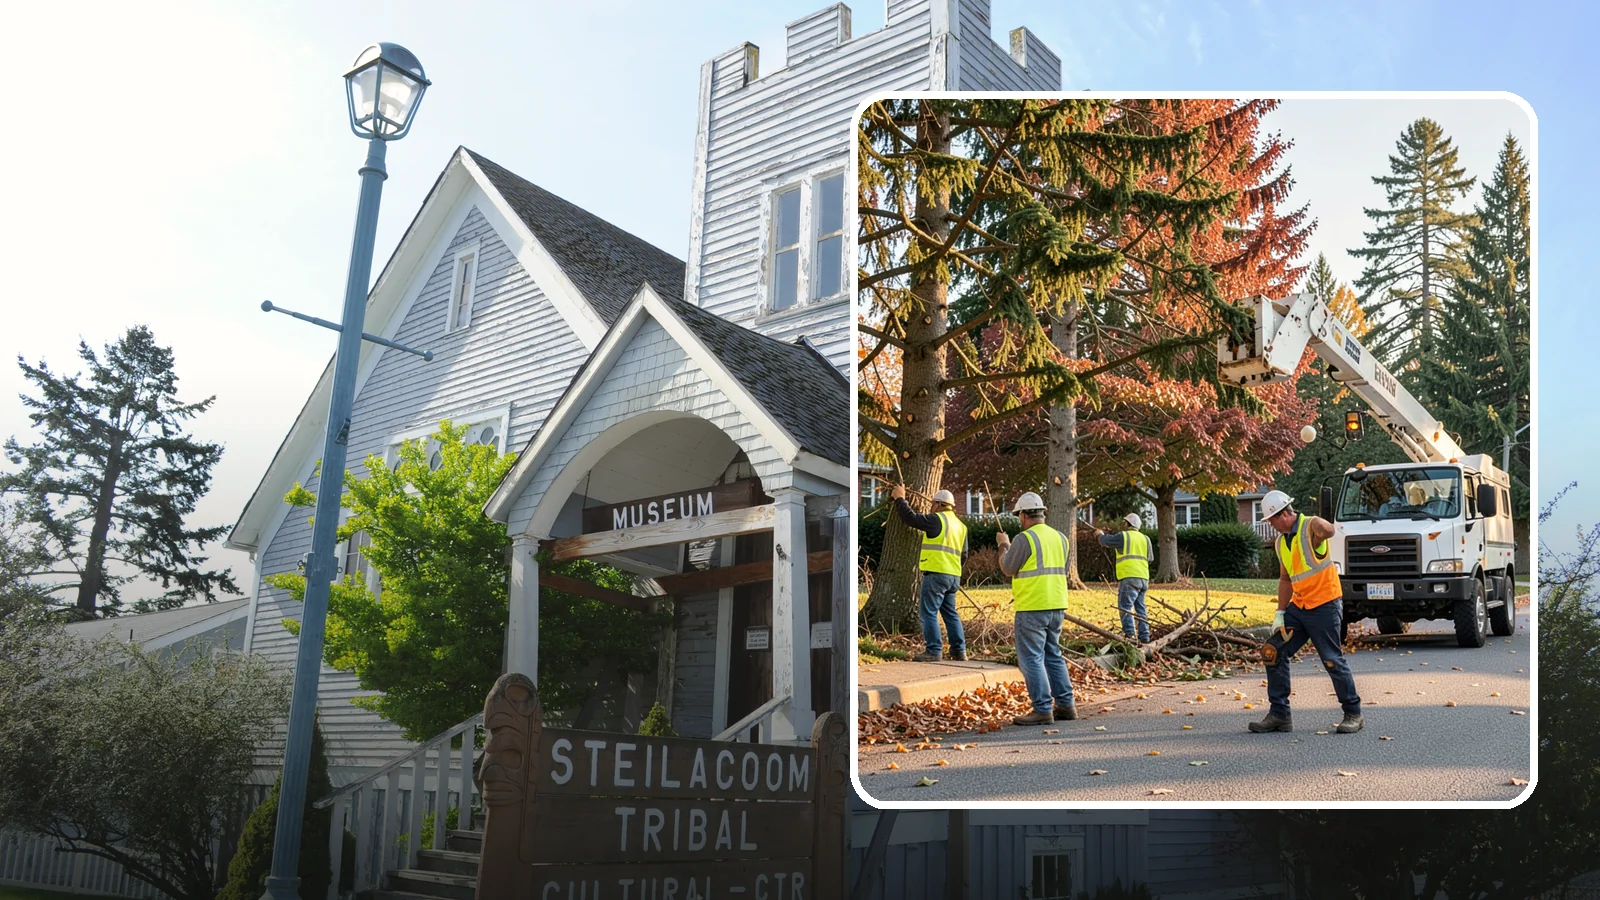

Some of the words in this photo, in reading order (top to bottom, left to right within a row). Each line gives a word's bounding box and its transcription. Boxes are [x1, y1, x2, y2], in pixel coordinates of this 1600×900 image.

[613, 491, 714, 531] MUSEUM
[550, 738, 810, 792] STEILACOOM
[614, 806, 758, 852] TRIBAL
